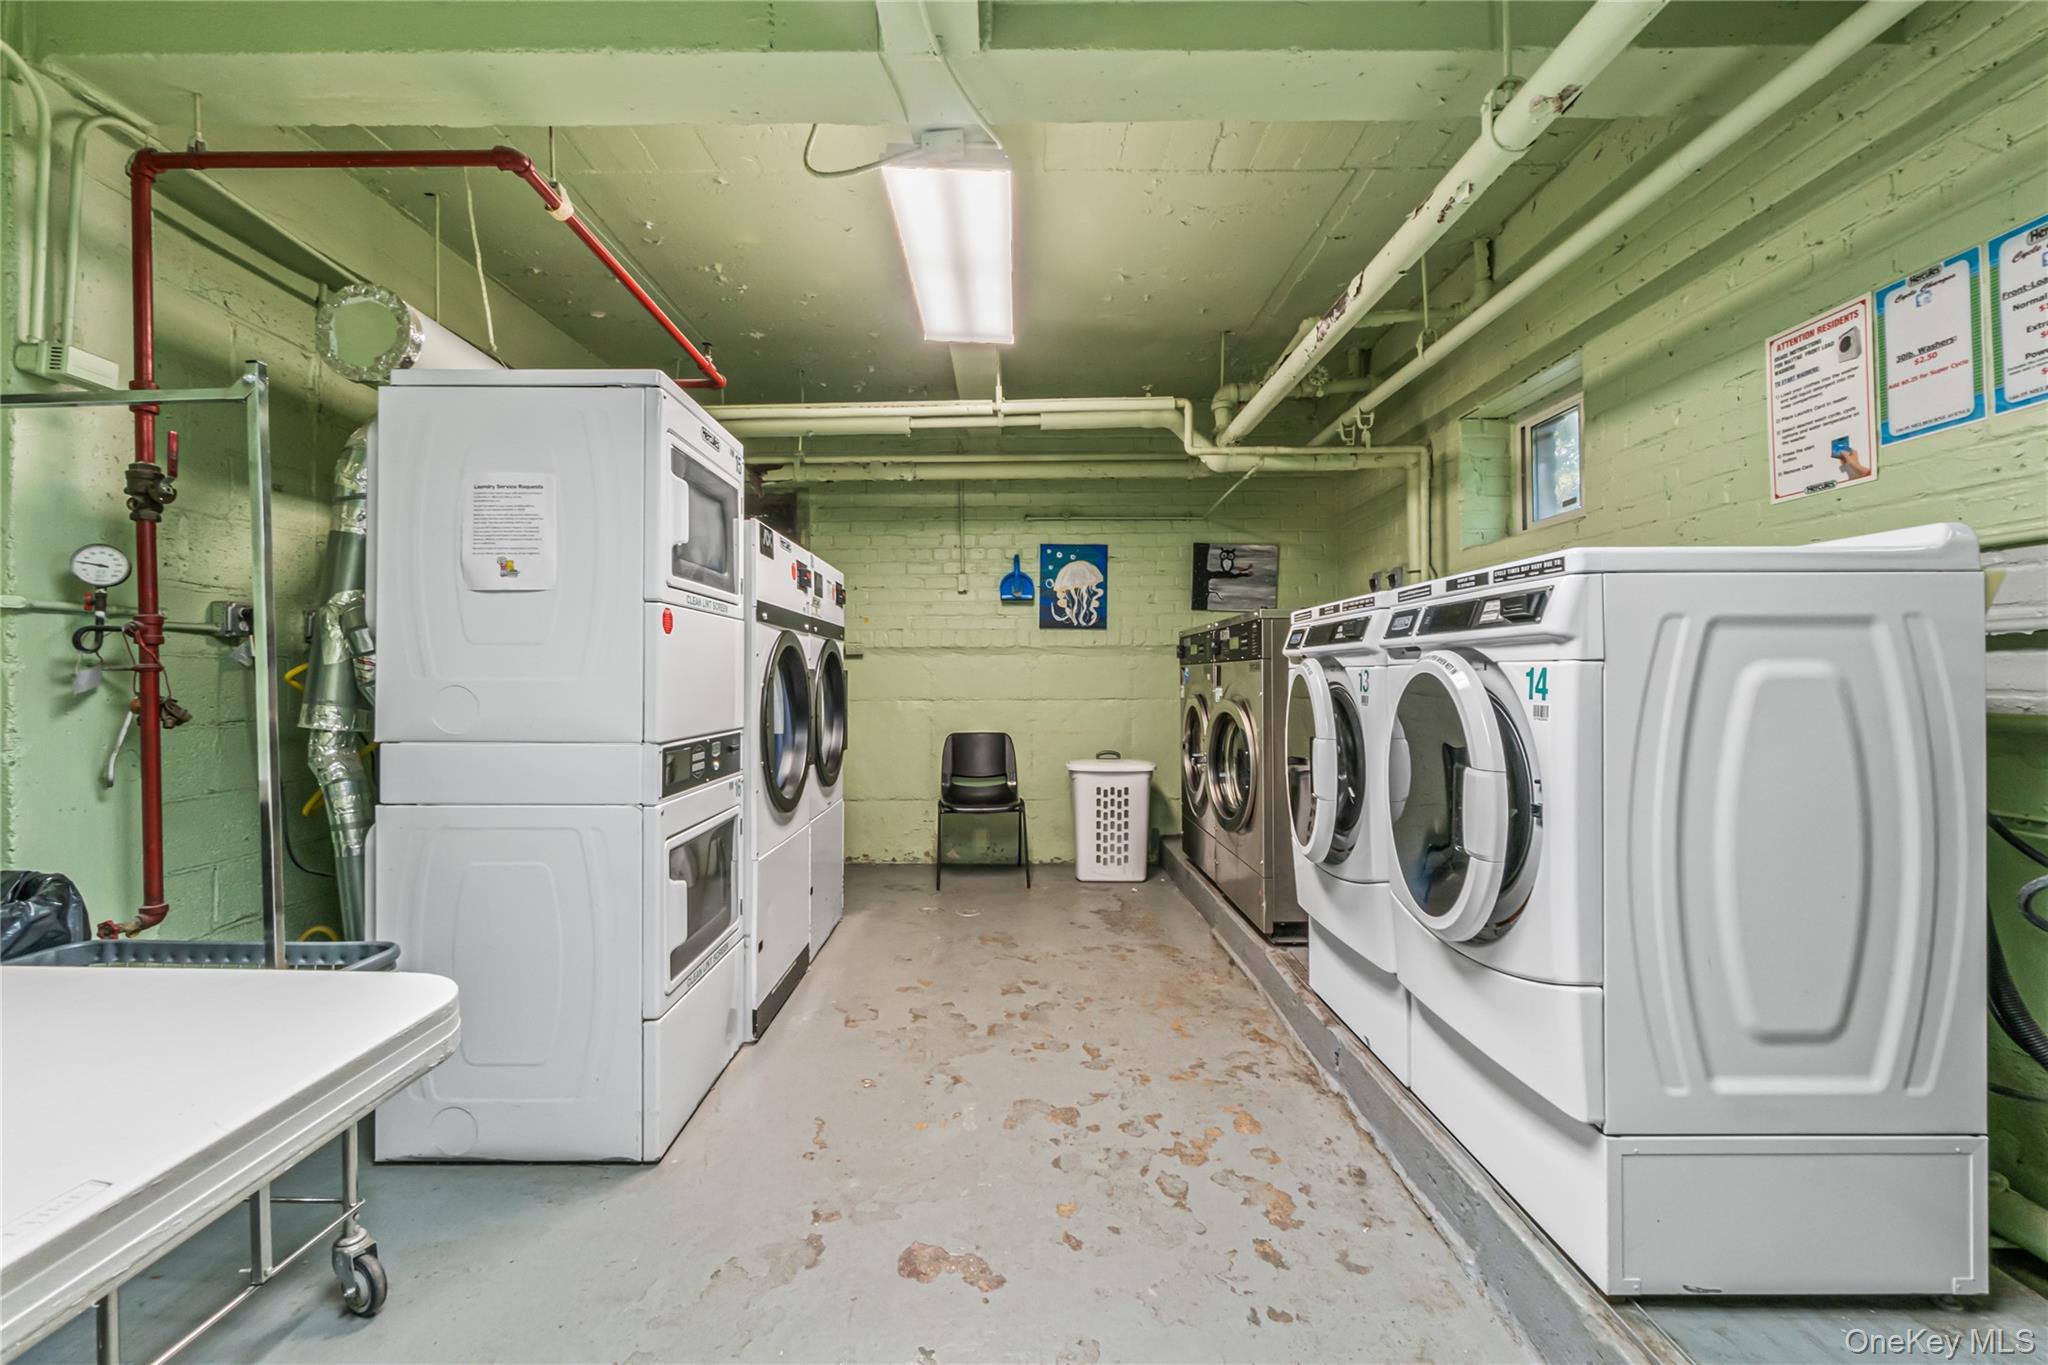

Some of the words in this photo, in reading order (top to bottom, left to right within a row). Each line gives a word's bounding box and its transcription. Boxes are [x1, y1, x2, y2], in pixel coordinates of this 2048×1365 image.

[2013, 292, 2048, 311] Normal
[1776, 330, 1815, 352] ATTENTION
[1817, 309, 1859, 334] RESIDENTS
[2026, 320, 2048, 333] Extr
[1805, 345, 1820, 357] FRONT
[1821, 340, 1834, 350] LOAD
[1914, 352, 1938, 366] $2.50
[1930, 365, 1948, 376] Super
[1950, 358, 1968, 370] Cycle
[1358, 670, 1370, 692] 13
[1526, 667, 1548, 701] 14
